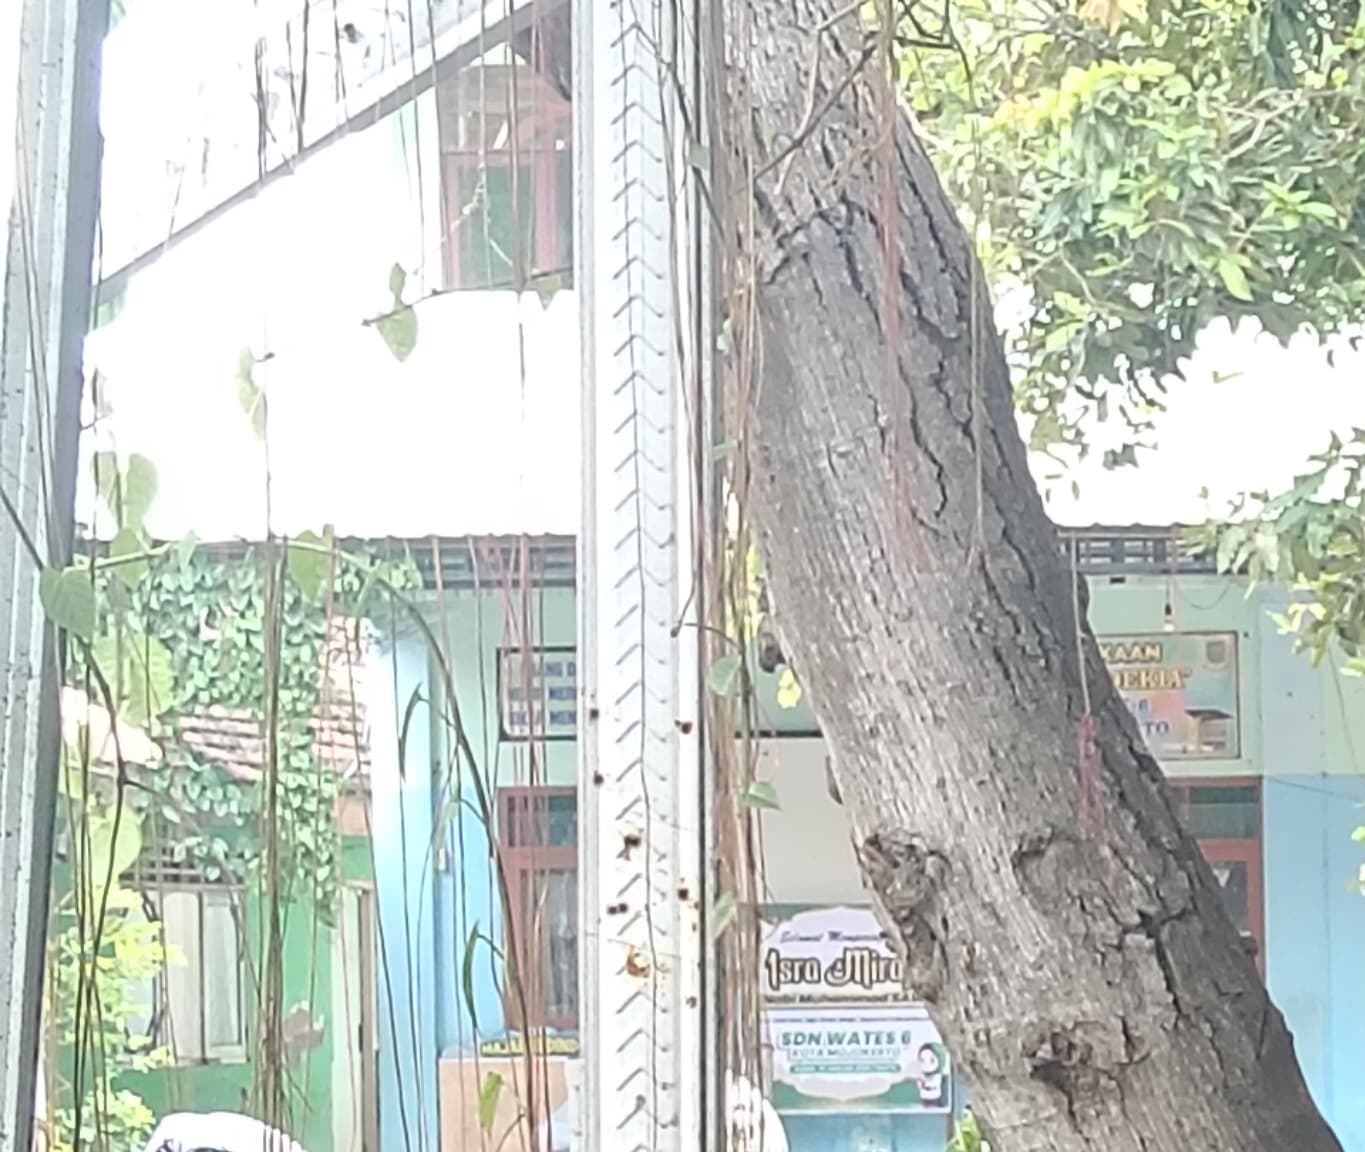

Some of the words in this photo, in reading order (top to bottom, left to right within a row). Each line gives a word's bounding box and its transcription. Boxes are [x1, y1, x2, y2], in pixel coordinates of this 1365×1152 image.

[824, 946, 903, 990] Mira
[781, 1032, 821, 1047] SDN
[827, 1031, 896, 1047] WATES
